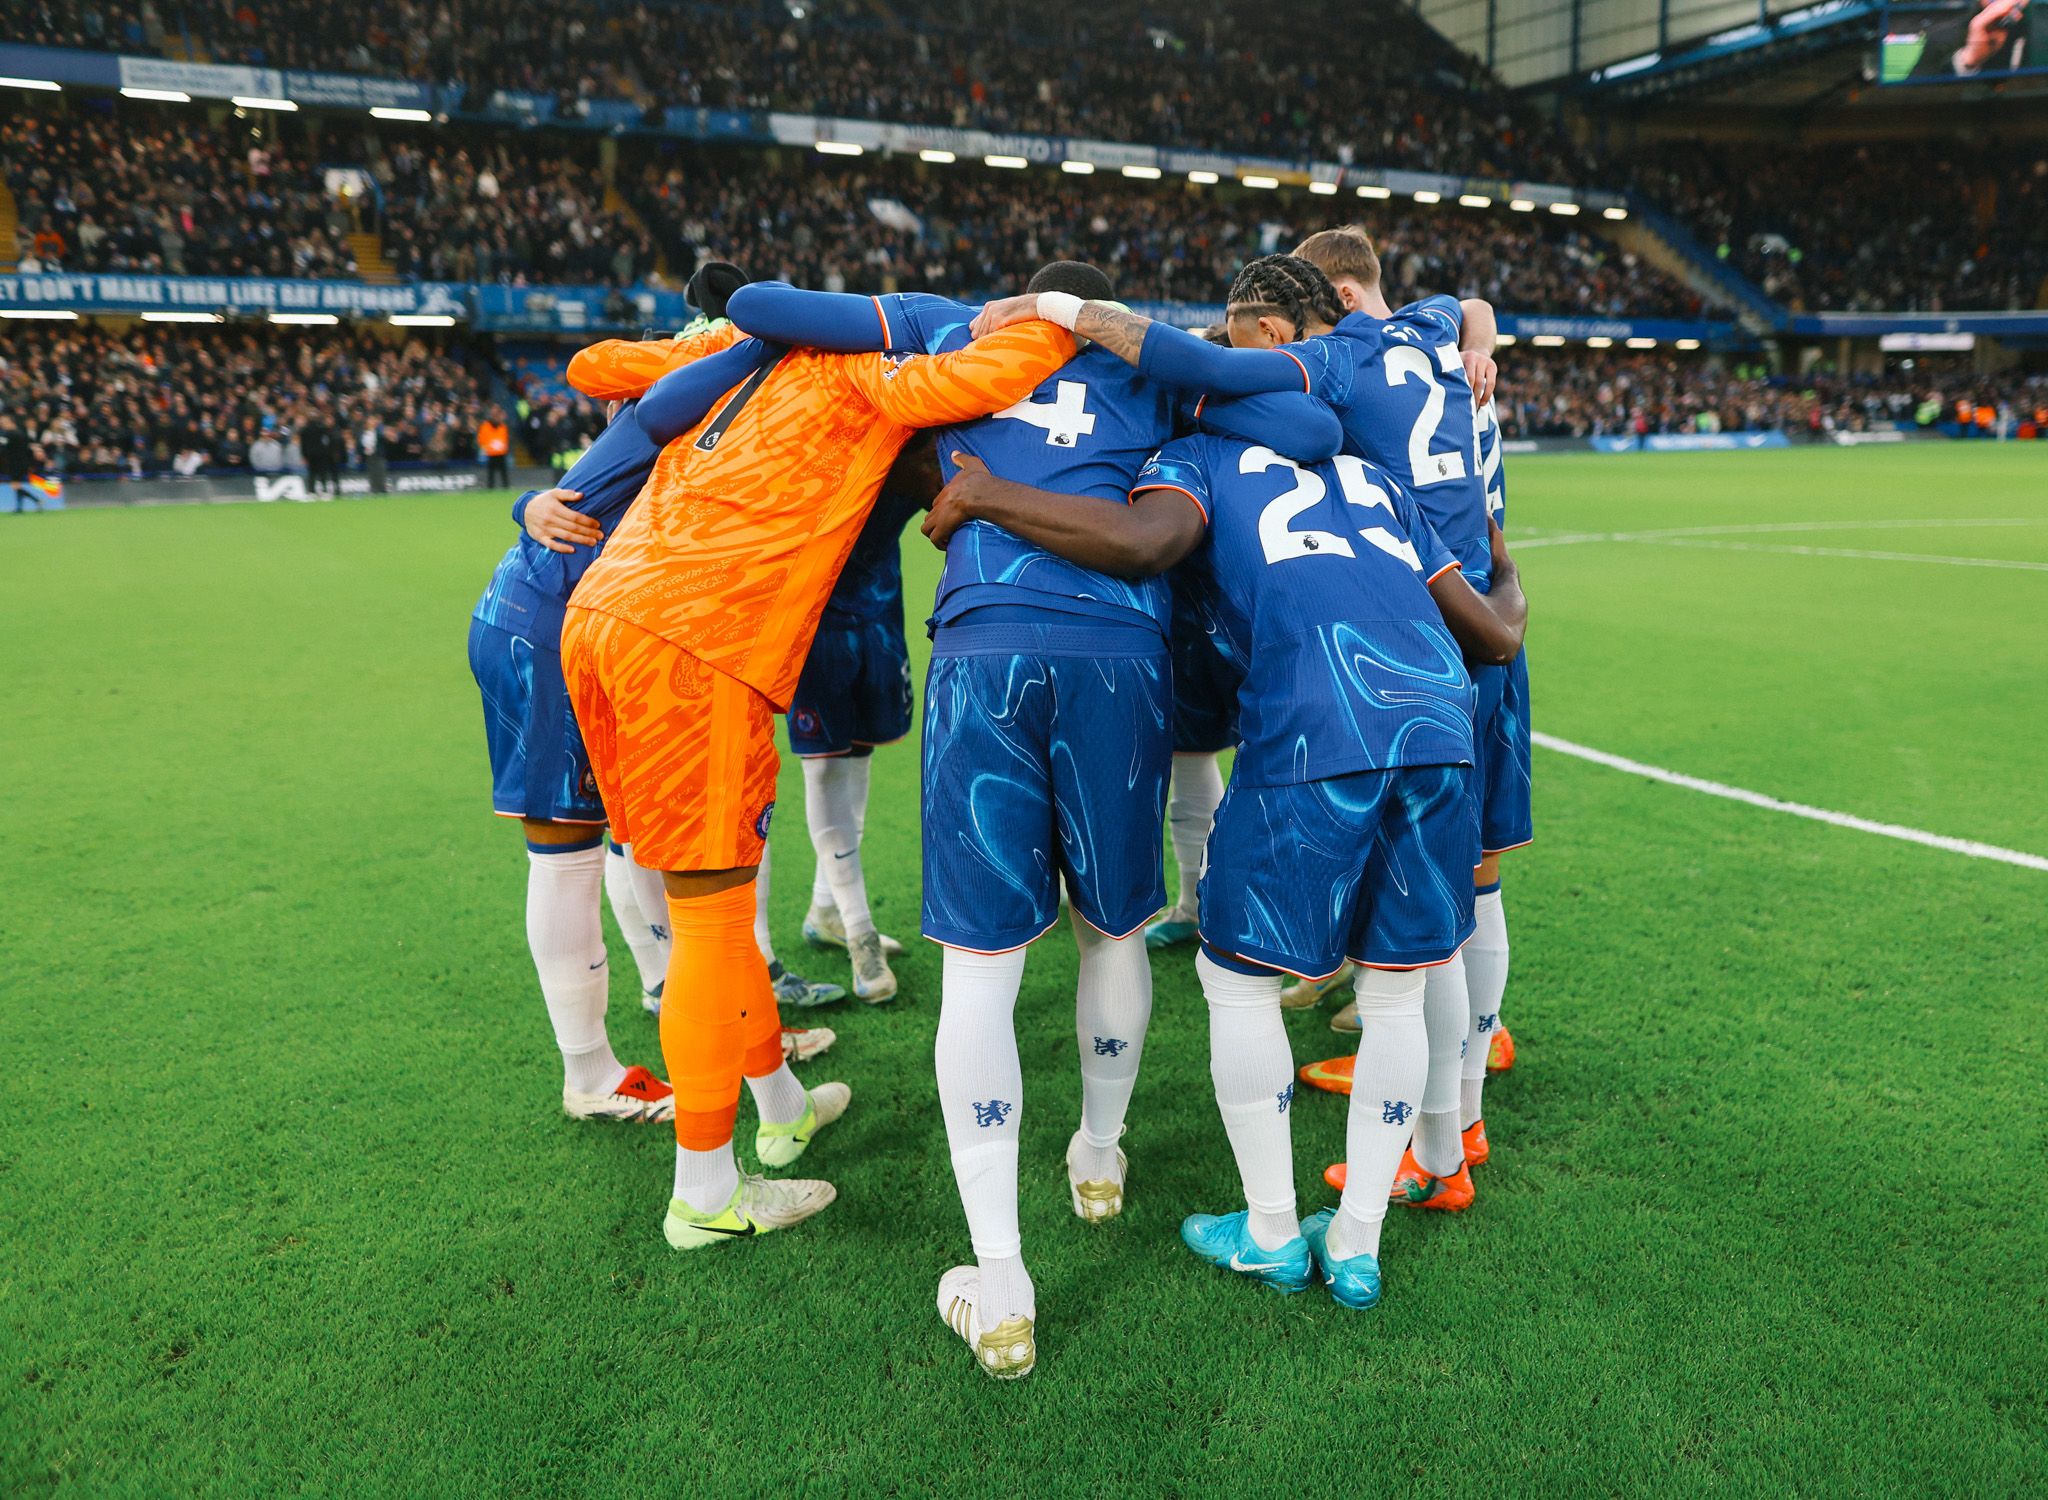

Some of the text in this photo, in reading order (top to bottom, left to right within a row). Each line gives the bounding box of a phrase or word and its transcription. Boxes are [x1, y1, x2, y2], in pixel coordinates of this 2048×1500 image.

[22, 276, 94, 302] DON'T
[99, 277, 165, 304] MAKE
[992, 379, 1096, 448] 4
[1238, 445, 1425, 572] 25
